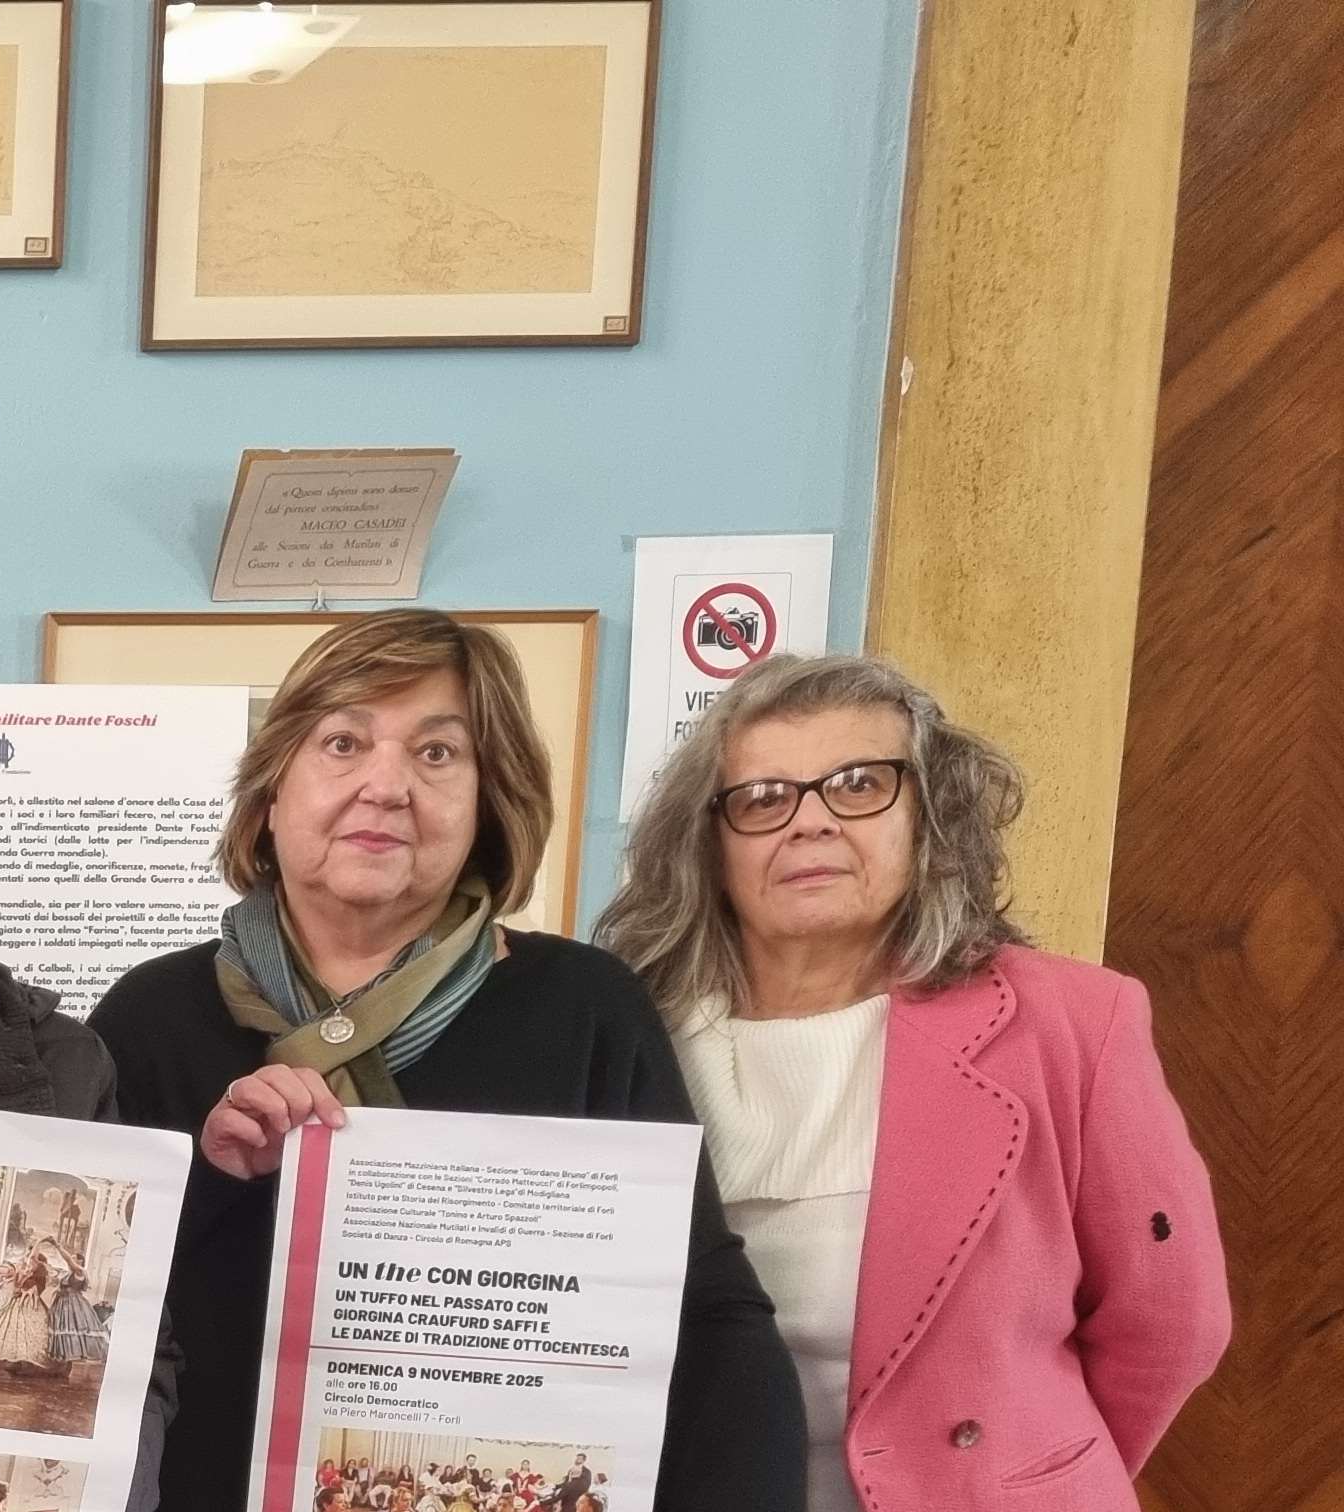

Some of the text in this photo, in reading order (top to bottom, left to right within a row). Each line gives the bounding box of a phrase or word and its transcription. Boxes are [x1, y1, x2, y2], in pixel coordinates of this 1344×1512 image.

[354, 518, 406, 529] CASADEI
[55, 715, 102, 726] Dante
[104, 714, 158, 727] Foschi
[19, 797, 24, 806] è
[27, 796, 65, 806] allestito
[67, 796, 82, 806] nel
[84, 796, 115, 806] salone
[157, 797, 180, 806] della
[183, 798, 206, 807] Casa
[209, 798, 224, 807] del
[97, 823, 148, 834] presidente
[155, 823, 184, 832] Dante
[19, 835, 48, 844] storici
[54, 835, 82, 846] (dalle
[88, 835, 110, 845] lotte
[117, 838, 134, 847] per
[24, 860, 33, 870] di
[190, 862, 214, 873] fregi
[54, 874, 80, 885] quelli
[84, 874, 107, 883] della
[111, 874, 147, 883] Grande
[150, 874, 185, 884] Guerra
[198, 874, 220, 884] della
[48, 900, 62, 909] sia
[65, 902, 82, 911] per
[84, 900, 90, 909] il
[92, 900, 112, 909] loro
[114, 900, 146, 909] valore
[188, 901, 201, 910] sia
[204, 904, 220, 912] per
[339, 1261, 580, 1293] UN the CON GIORGINA
[336, 1289, 548, 1315] UN TUFFO NEL PASSATO CON
[334, 1308, 551, 1334] GIORGINA CRAUFURD SAFFI E
[332, 1326, 630, 1358] LE DANZE DI TRADIZIONE OTTOCENTESCA
[327, 1361, 544, 1388] DOMENICA 9 NOVEMBRE 2025
[326, 1378, 398, 1392] alle ore 16.00
[324, 1392, 439, 1410] Circolo Democratico
[323, 1406, 338, 1416] via
[340, 1406, 367, 1418] Piero
[370, 1409, 422, 1422] Maroncelli
[424, 1413, 430, 1422] 7
